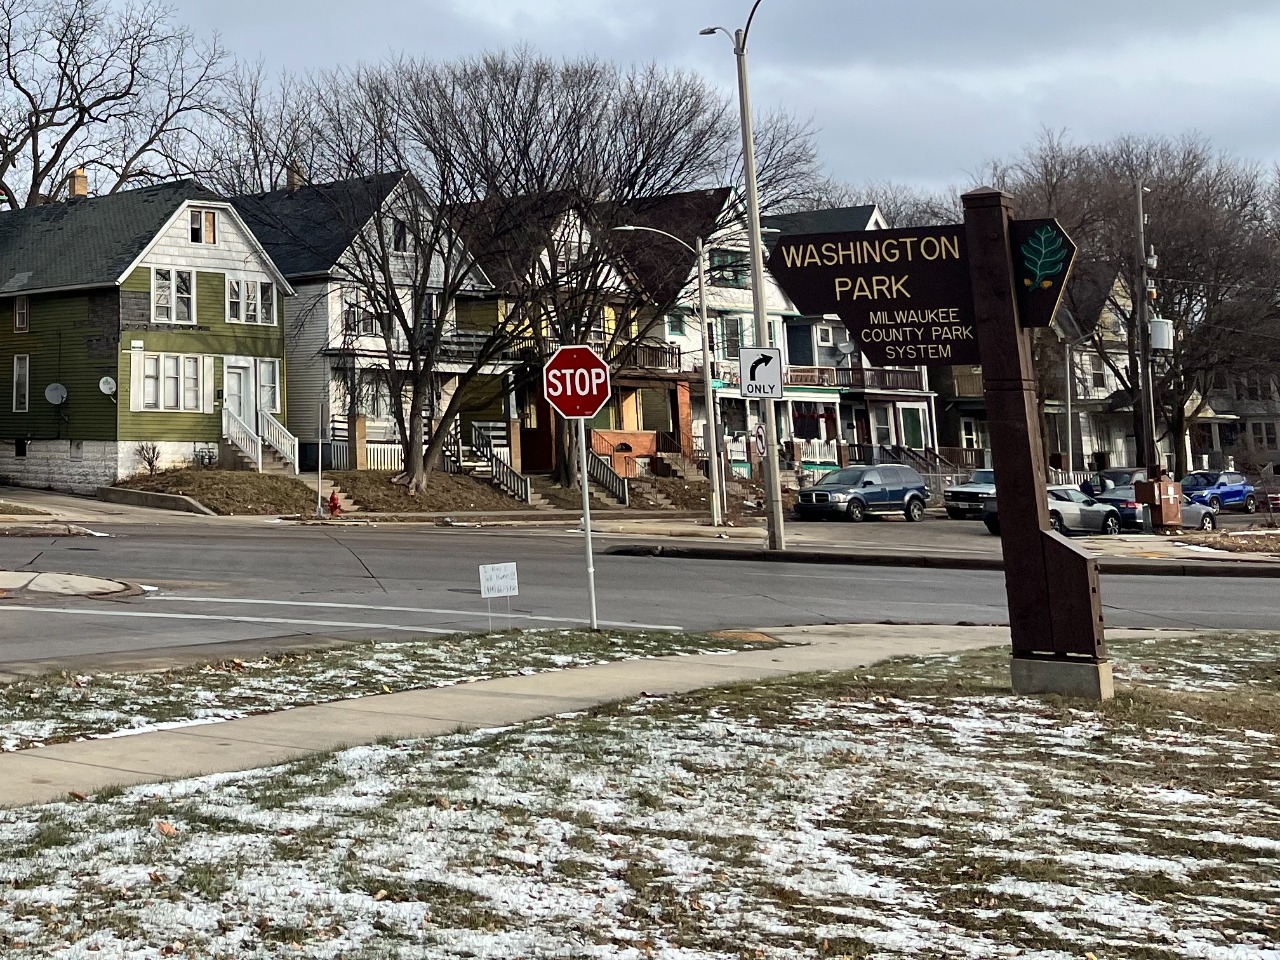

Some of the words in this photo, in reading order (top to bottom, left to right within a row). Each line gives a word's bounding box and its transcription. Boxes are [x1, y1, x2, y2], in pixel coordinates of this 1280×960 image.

[782, 235, 960, 268] WASHINGTON
[835, 275, 911, 301] PARK
[870, 308, 960, 325] MILWAUKEE
[861, 328, 924, 343] COUNTY
[932, 325, 974, 340] PARK
[885, 344, 952, 359] SYSTEM
[548, 368, 606, 397] STOP
[746, 384, 776, 394] ONLY
